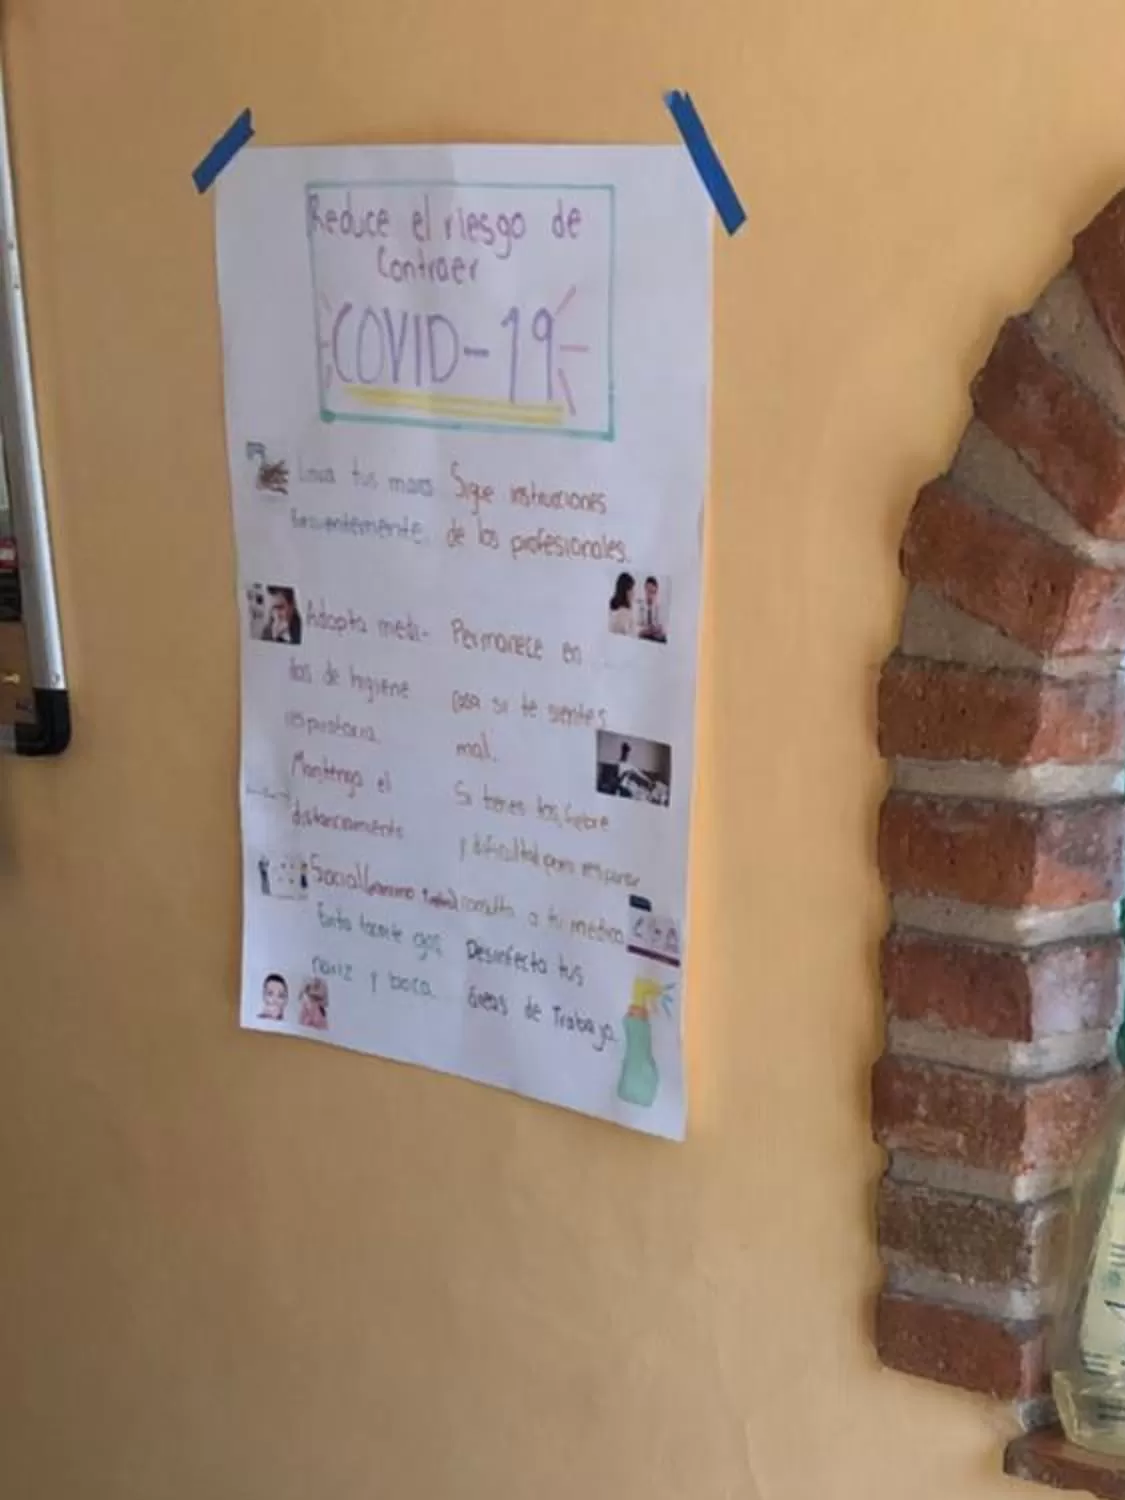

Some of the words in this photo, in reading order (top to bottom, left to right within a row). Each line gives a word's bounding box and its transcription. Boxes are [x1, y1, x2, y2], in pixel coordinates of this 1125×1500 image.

[307, 194, 390, 241] Reduce
[412, 195, 431, 243] el
[443, 205, 527, 260] riesgo
[552, 199, 583, 240] de
[331, 302, 554, 403] COVID-19
[446, 517, 466, 549] de
[477, 516, 500, 550] los
[562, 639, 582, 666] en
[322, 659, 341, 687] de
[349, 664, 411, 704] higiene
[521, 692, 539, 719] te
[375, 768, 393, 794] el
[557, 951, 585, 988] tus
[524, 994, 544, 1023] de
